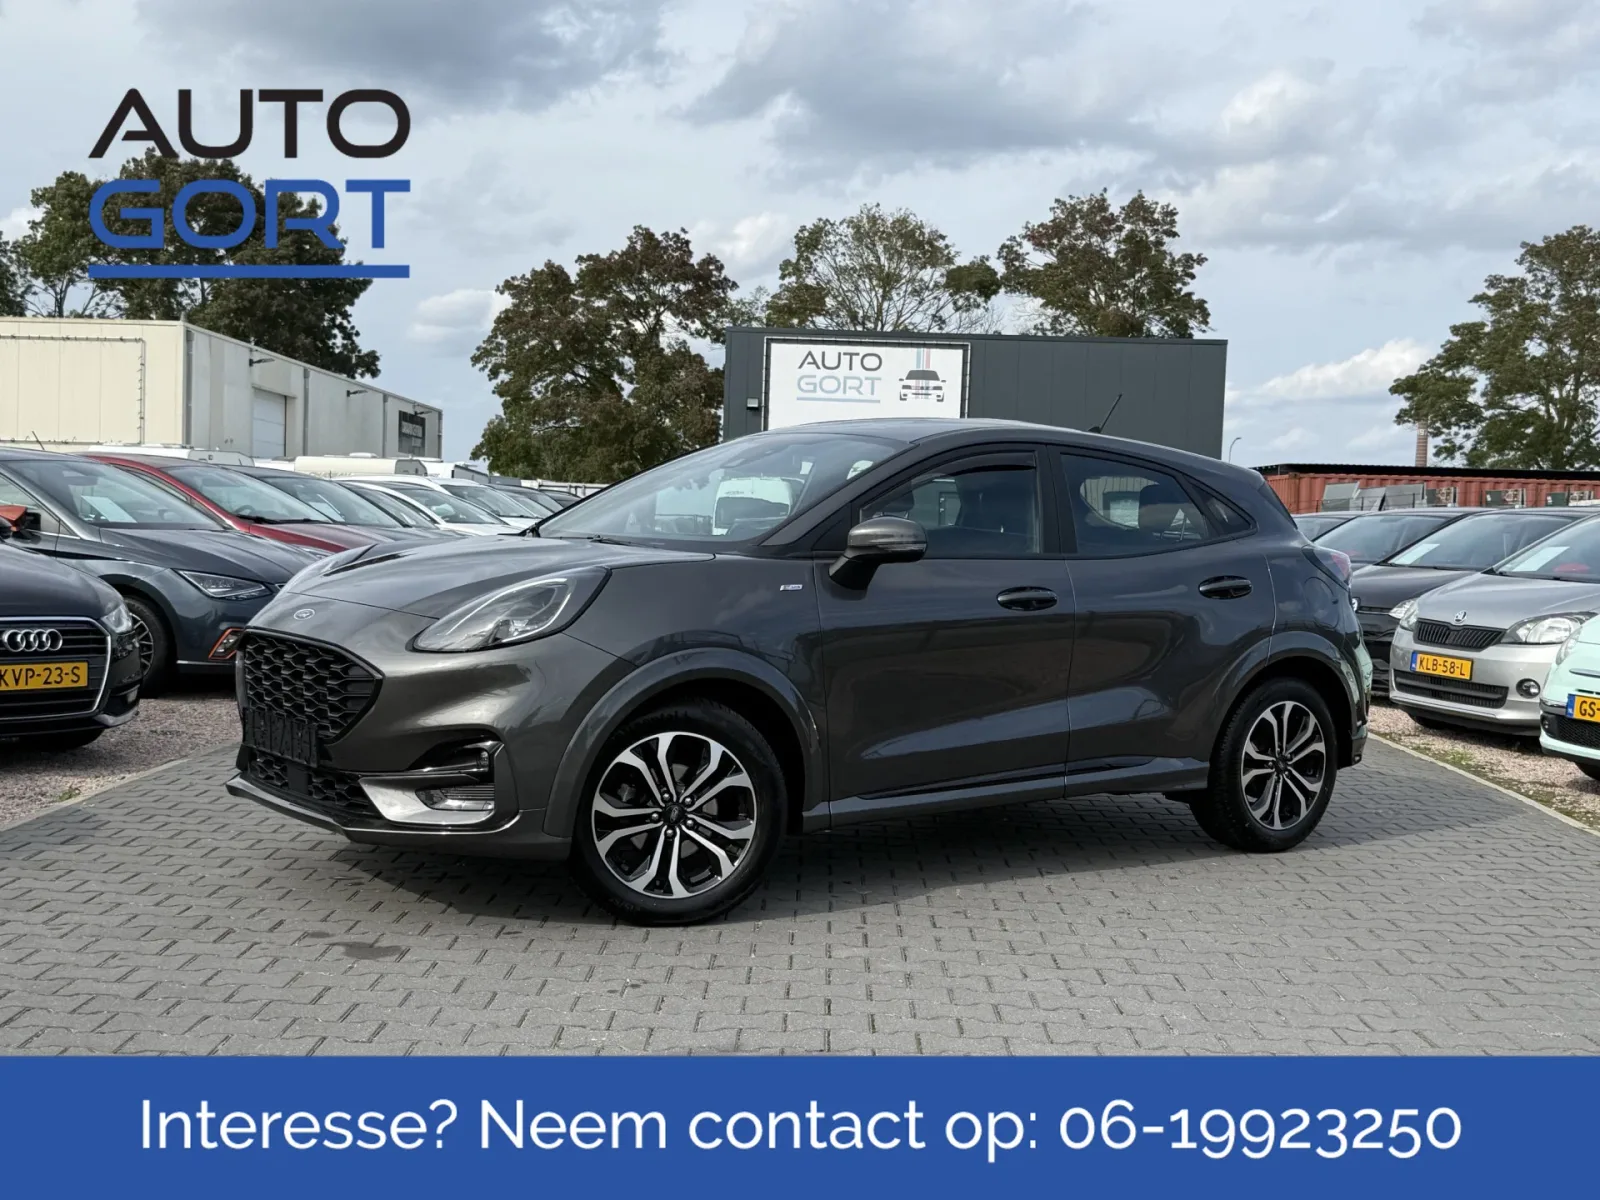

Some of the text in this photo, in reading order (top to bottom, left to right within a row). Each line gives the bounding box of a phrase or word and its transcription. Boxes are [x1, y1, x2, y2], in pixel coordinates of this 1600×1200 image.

[798, 350, 882, 372] AUTO
[797, 374, 882, 396] GORT
[0, 665, 81, 687] KVP-23-S
[1419, 656, 1466, 677] KLB-58-L
